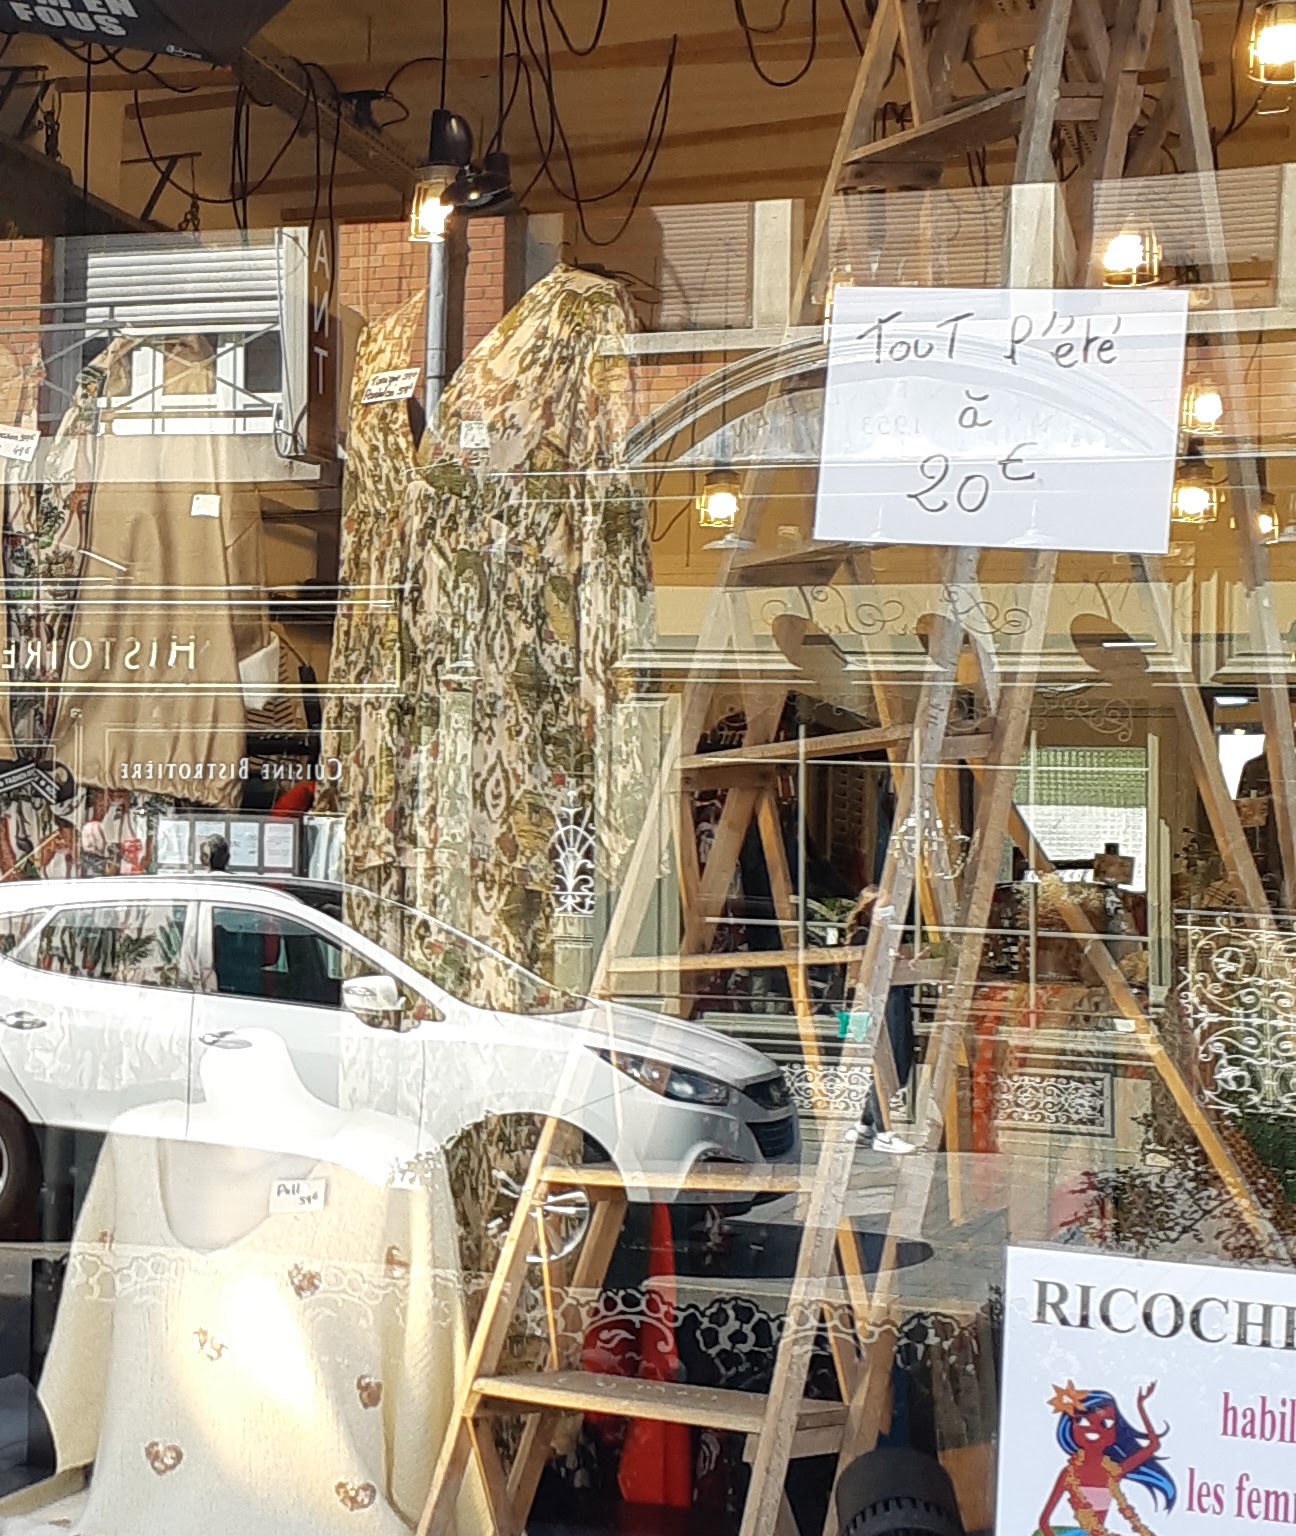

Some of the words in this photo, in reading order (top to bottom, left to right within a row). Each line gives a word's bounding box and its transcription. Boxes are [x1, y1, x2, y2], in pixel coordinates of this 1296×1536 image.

[9, 0, 128, 37] FOUS
[907, 442, 1037, 515] 20€
[1186, 1467, 1225, 1515] les
